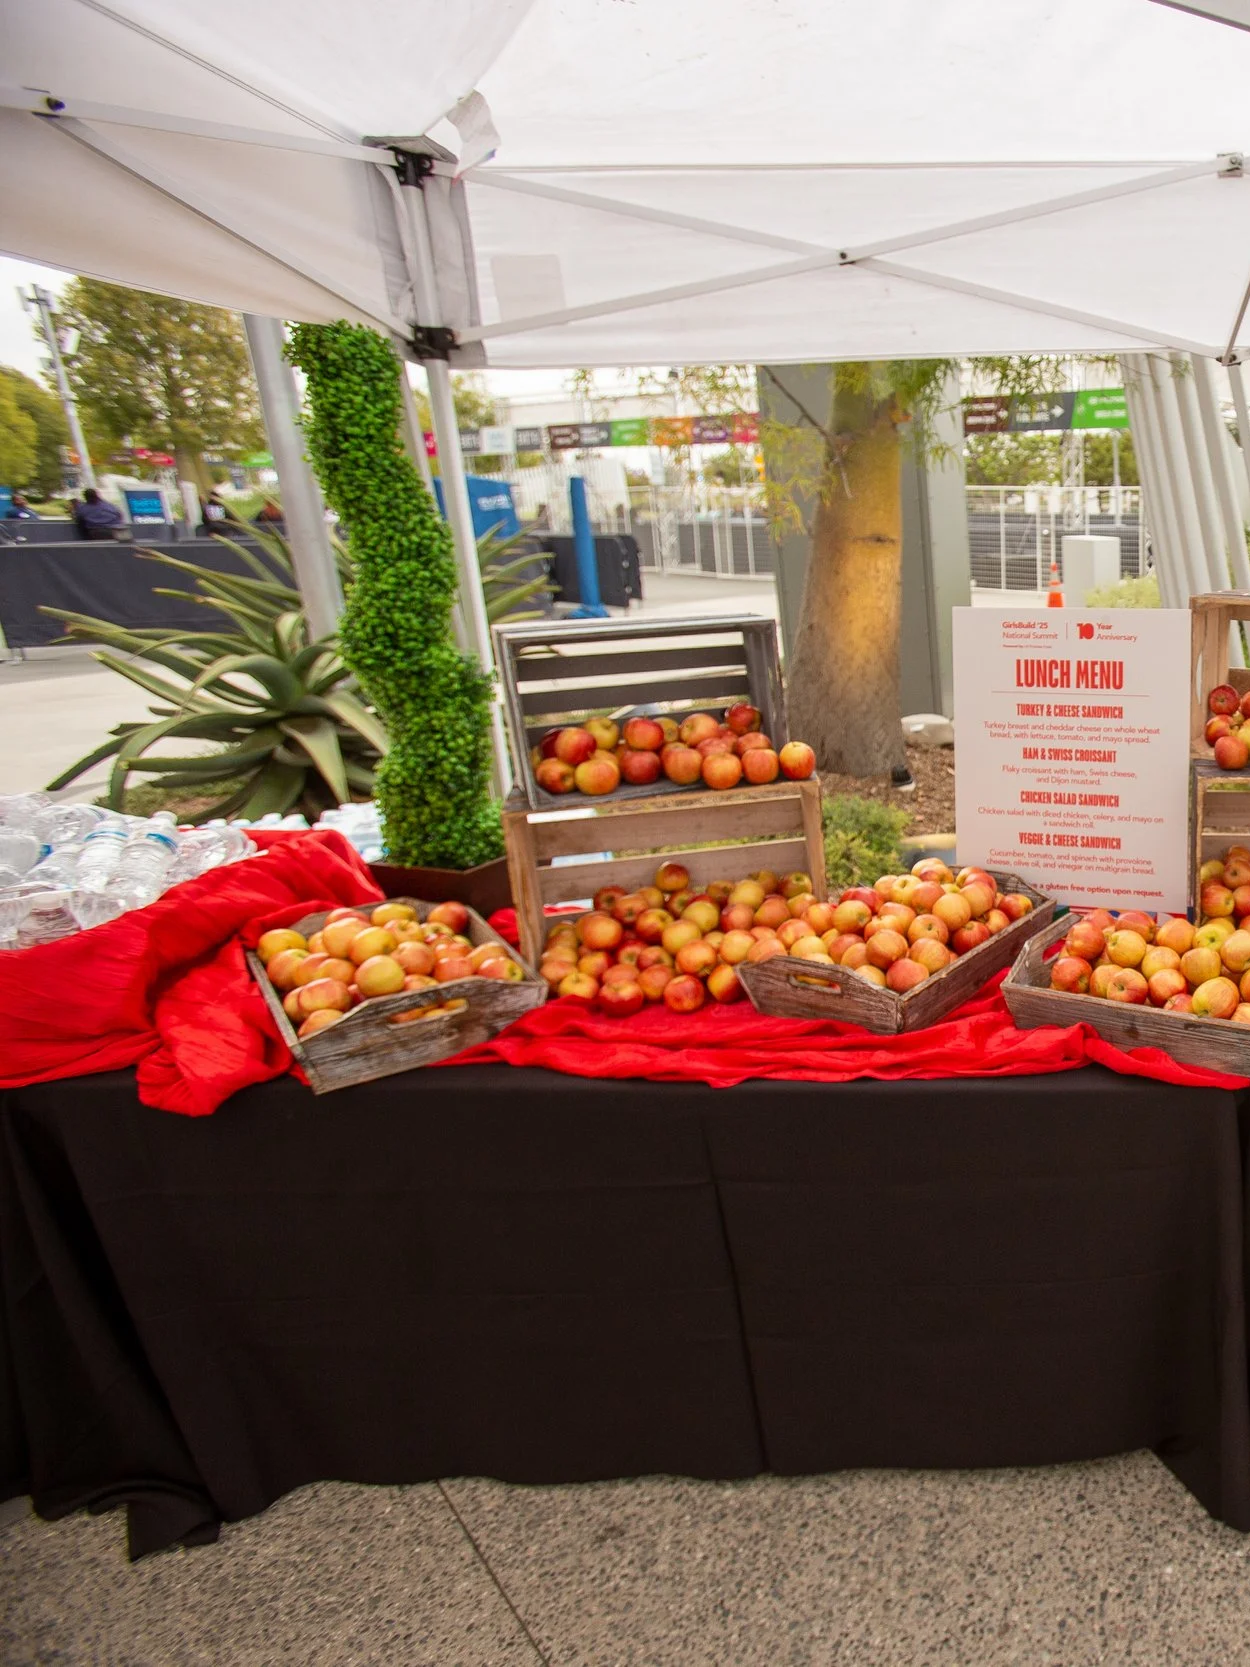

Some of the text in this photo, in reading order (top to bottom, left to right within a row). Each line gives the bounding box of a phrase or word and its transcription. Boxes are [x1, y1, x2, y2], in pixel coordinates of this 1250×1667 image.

[1002, 621, 1036, 629] GirlsBuild
[1077, 623, 1094, 640] 10
[1002, 631, 1058, 640] National Summit
[1097, 633, 1138, 643] Anniversary
[1016, 659, 1124, 690] LUNCH MENU
[1017, 704, 1124, 719] TURKEY & CHEESE SANDWICH
[984, 721, 1006, 731] Turkey
[1007, 722, 1029, 730] breast
[1031, 723, 1044, 731] and
[1046, 723, 1075, 732] cheddar
[1076, 725, 1102, 733] cheese
[1115, 726, 1135, 734] whole
[1138, 727, 1160, 735] wheat
[1030, 732, 1056, 741] lettuce,
[1057, 734, 1085, 742] tomato,
[1087, 734, 1101, 742] and
[1102, 736, 1122, 744] mayo
[1124, 736, 1150, 745] spread.
[1023, 747, 1117, 763] HAM & SWISS CROISSANT
[1002, 765, 1020, 775] Flaky
[1021, 766, 1052, 775] croissant
[1054, 767, 1069, 775] with
[1089, 768, 1109, 777] Swiss
[1051, 776, 1070, 786] Dijon
[1020, 790, 1120, 808] CHICKEN SALAD SANDWICH
[978, 807, 1005, 816] Chicken
[1026, 809, 1040, 817] with
[1042, 810, 1062, 818] diced
[1063, 811, 1091, 820] chicken,
[1093, 813, 1116, 823] celery,
[1117, 814, 1131, 822] and
[1132, 815, 1153, 824] mayo
[1048, 819, 1081, 828] sandwich
[1018, 832, 1121, 850] VEGGIE & CHEESE SANDWICH
[1027, 851, 1053, 860] tomato,
[1056, 852, 1070, 860] and
[1071, 852, 1100, 863] spinach
[1102, 855, 1114, 864] with
[1013, 859, 1029, 867] olive
[1043, 861, 1056, 869] and
[1058, 862, 1083, 872] vinegar
[1096, 863, 1131, 874] multigrain
[1046, 883, 1069, 893] gluten
[1070, 883, 1085, 892] free
[1087, 885, 1111, 896] option
[1112, 888, 1131, 897] upon
[1133, 889, 1164, 898] request.
